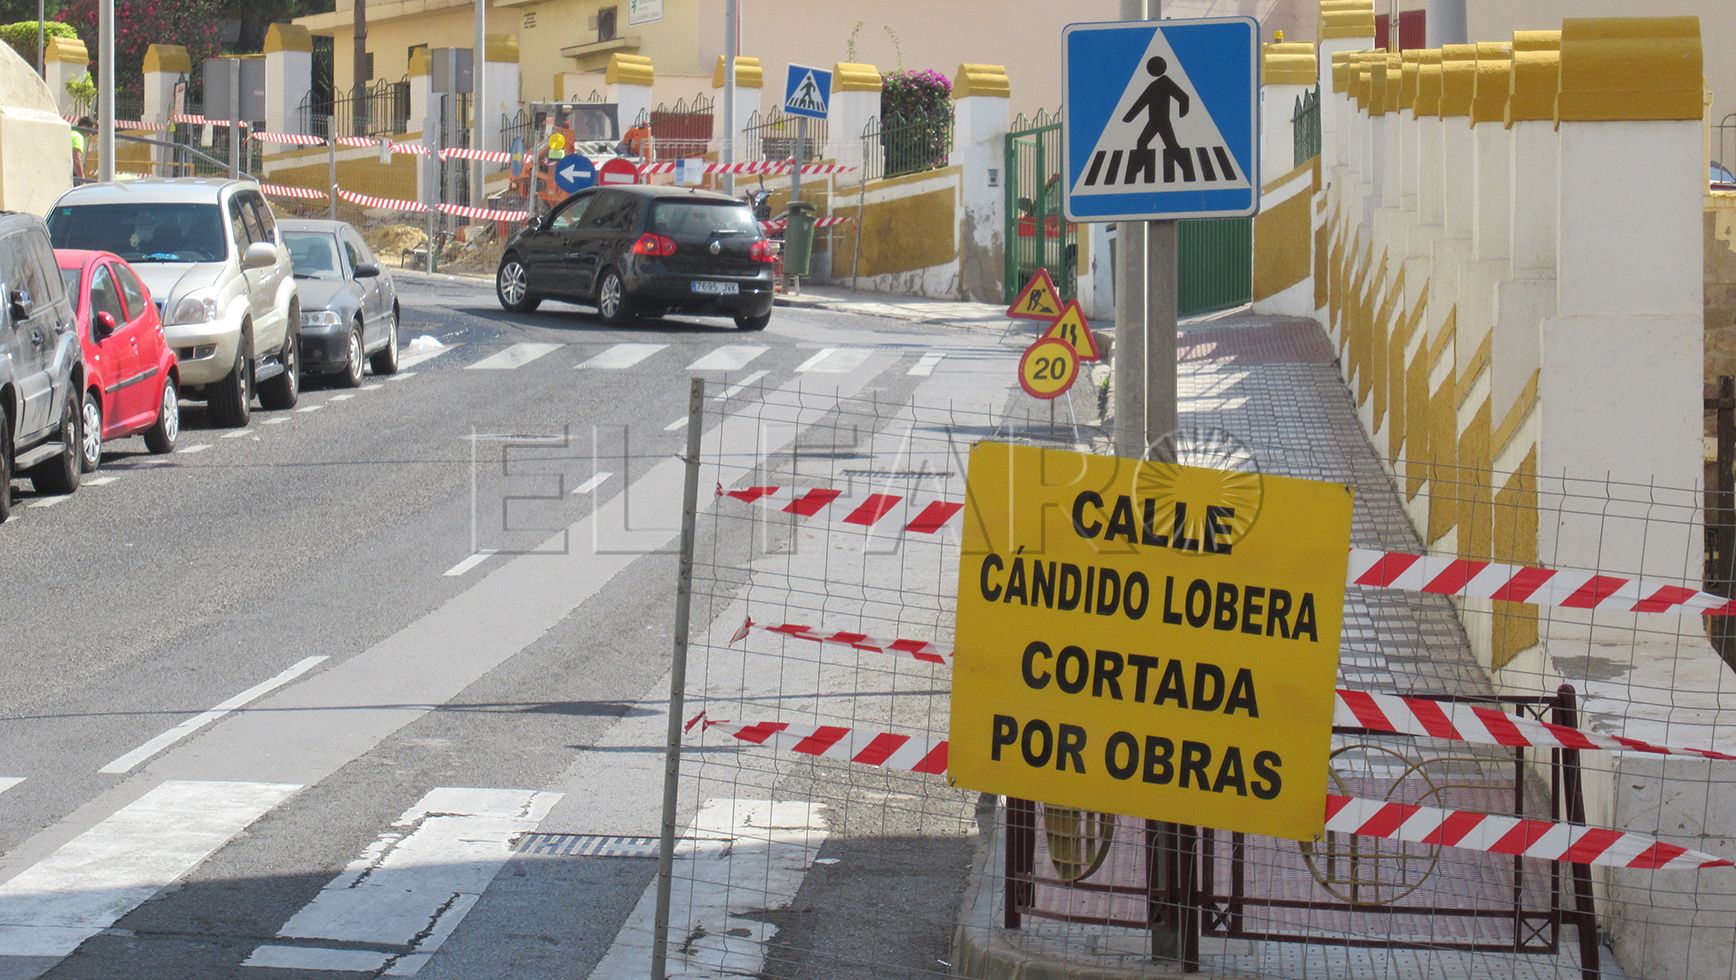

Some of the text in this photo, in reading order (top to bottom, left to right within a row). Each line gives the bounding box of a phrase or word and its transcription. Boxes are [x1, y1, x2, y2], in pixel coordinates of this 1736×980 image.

[696, 280, 718, 291] 7695
[1033, 357, 1066, 380] 20
[1072, 490, 1236, 555] CALLE
[979, 545, 1319, 643] CÁNDIDO LOBERA
[1021, 641, 1260, 719] CORTADA
[991, 713, 1283, 801] POR OBRAS
